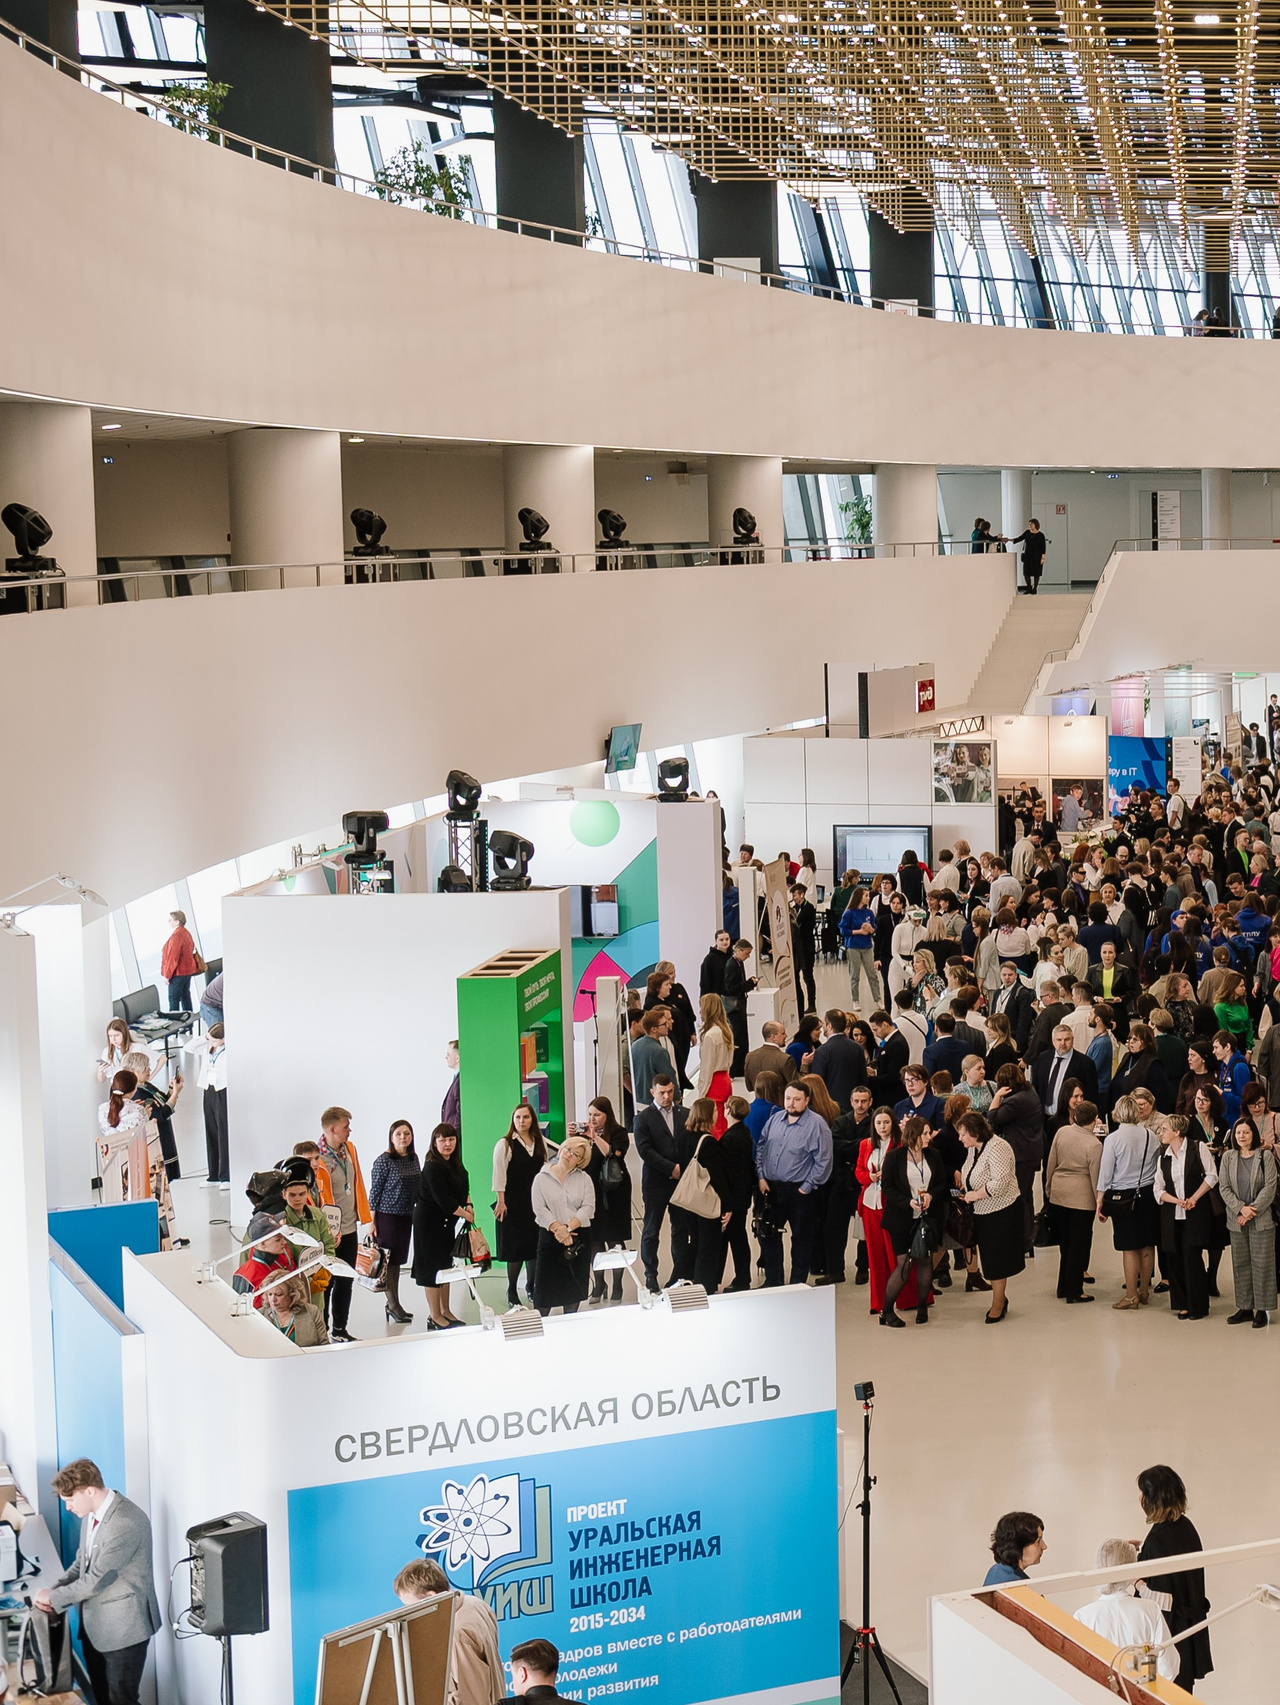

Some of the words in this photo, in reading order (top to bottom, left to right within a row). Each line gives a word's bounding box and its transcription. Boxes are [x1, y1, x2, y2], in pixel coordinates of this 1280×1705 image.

[1128, 767, 1137, 776] IT
[333, 1396, 620, 1463] СВЕРДЛОВСКАЯ
[631, 1375, 782, 1421] ОБЛАСТЬ
[566, 1498, 629, 1524] ПРОЕКТ
[567, 1510, 702, 1552] УРАЛЬСКАЯ
[568, 1535, 722, 1581] ИНЖЕНЕРНАЯ
[568, 1575, 654, 1610] ШКОЛА
[569, 1605, 647, 1634] 2015-2034
[558, 1644, 603, 1665] адров
[607, 1634, 664, 1656] вместе
[666, 1632, 677, 1644] с
[679, 1608, 803, 1646] работодателями
[556, 1661, 619, 1685] олодежи
[587, 1673, 660, 1702] развития
